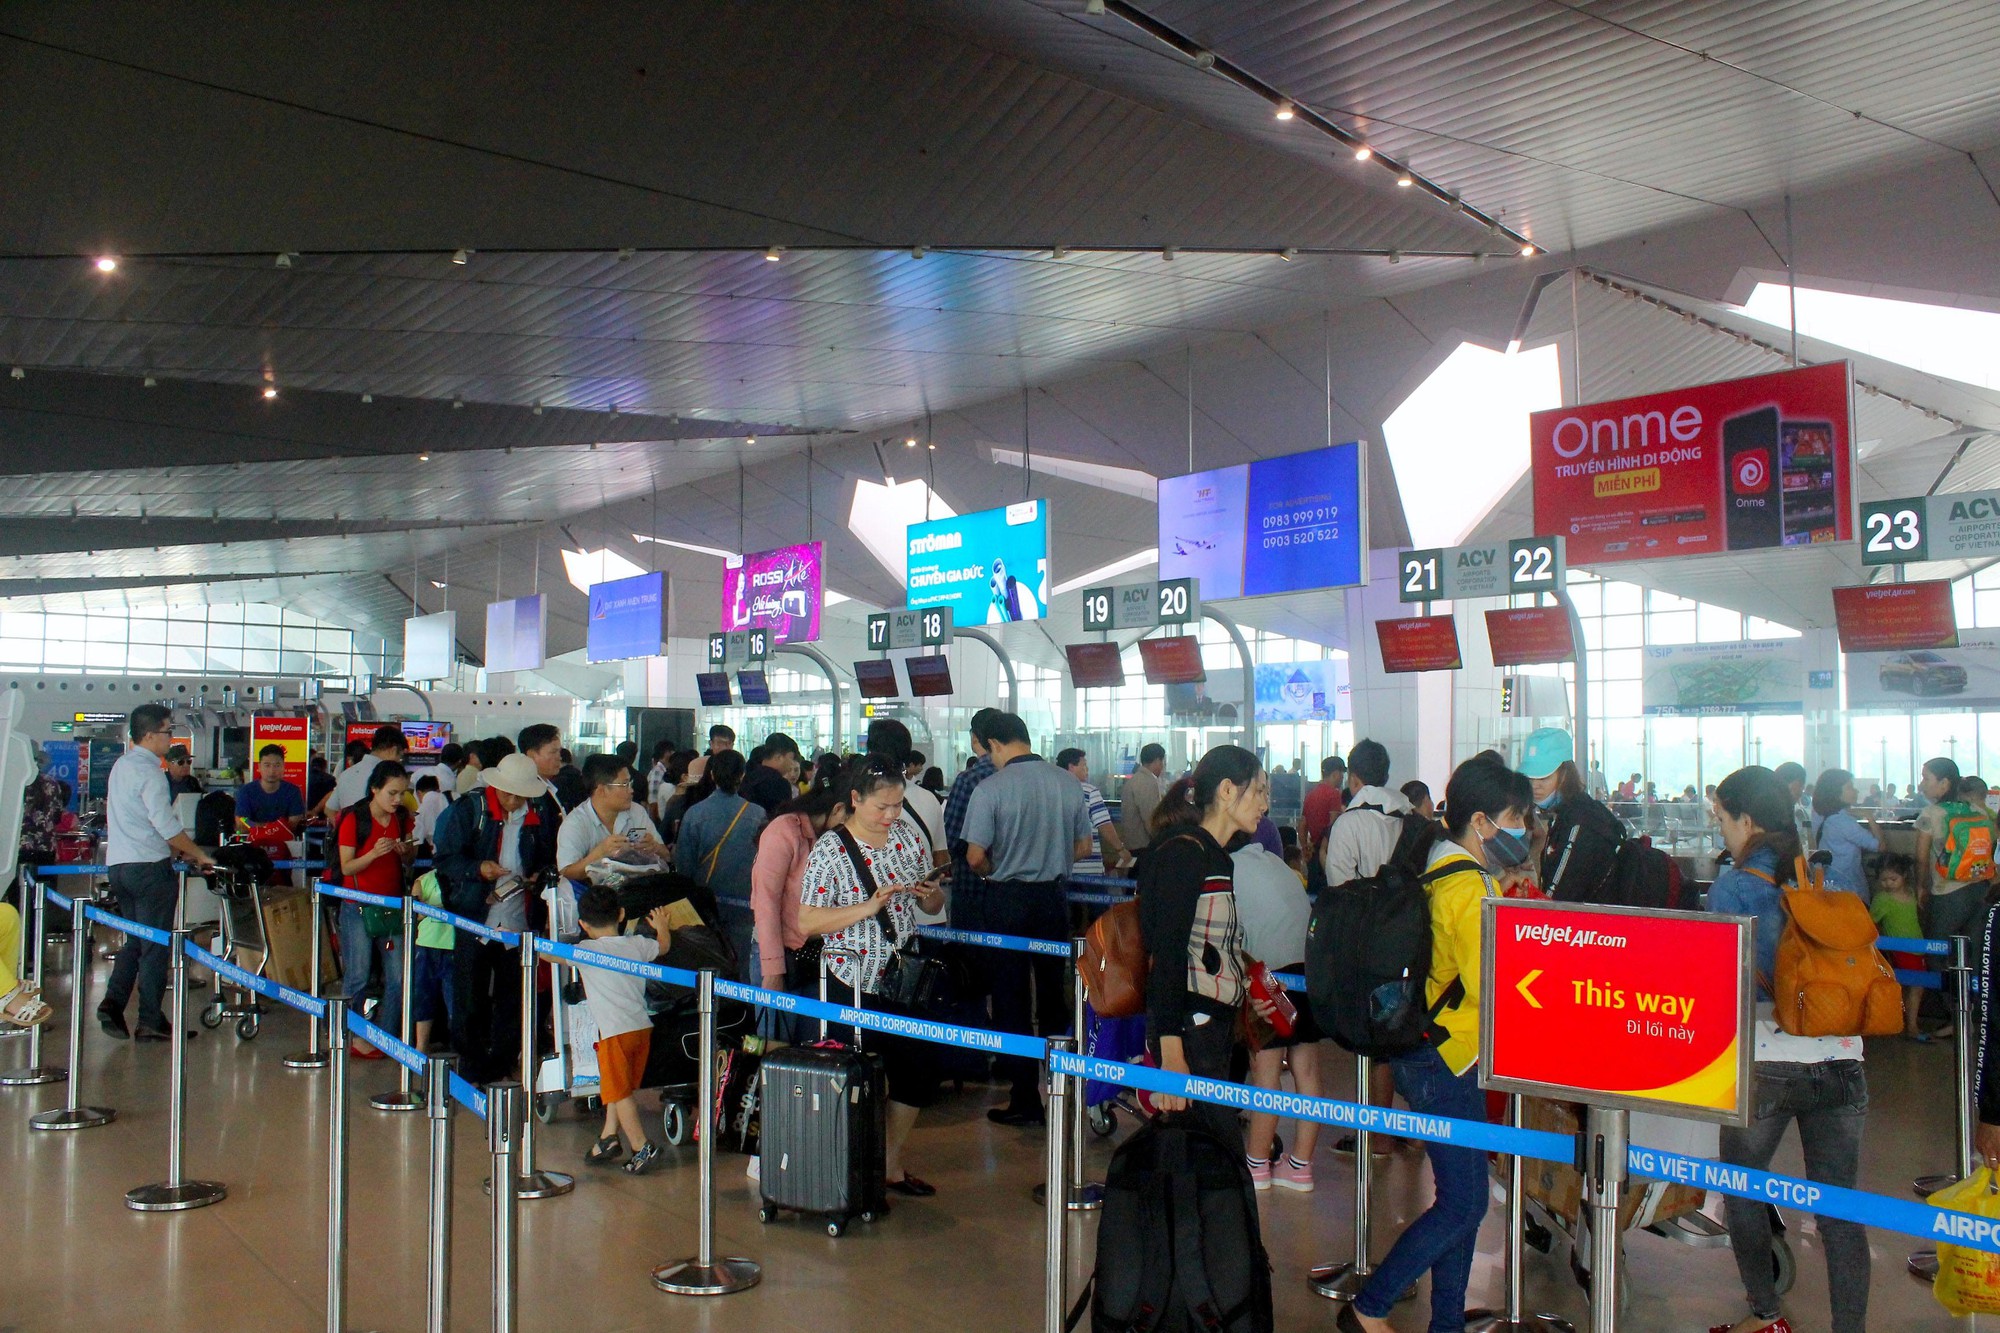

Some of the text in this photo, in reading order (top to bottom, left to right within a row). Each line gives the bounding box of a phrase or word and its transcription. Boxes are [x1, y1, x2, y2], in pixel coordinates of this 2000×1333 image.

[1552, 405, 1702, 458] Onme
[1608, 456, 1640, 471] HÌNH
[1644, 454, 1658, 466] DI
[1660, 447, 1702, 464] ĐỘNG
[1598, 470, 1656, 492] MIỄN PHÍ
[1736, 497, 1765, 508] Onme
[1263, 506, 1338, 528] 0983 999 919
[1264, 528, 1338, 548] 0903 520 522
[1866, 510, 1920, 552] 23
[1457, 550, 1496, 568] ACV
[1514, 546, 1552, 582] 22
[753, 570, 783, 587] ROSSI
[947, 569, 962, 582] GIA
[1405, 558, 1436, 592] 21
[1123, 588, 1149, 603] ACV
[1160, 586, 1188, 616] 20
[1086, 596, 1108, 622] 19
[870, 620, 886, 643] 17
[896, 615, 915, 626] ACV
[924, 614, 940, 638] 18
[711, 638, 722, 658] 15
[751, 634, 764, 654] 16
[1656, 706, 1674, 716] 750
[48, 764, 70, 778] 40
[1986, 907, 1997, 928] LOVE
[970, 934, 982, 943] NAM
[986, 936, 1002, 946] CTCP
[1028, 941, 1060, 954] AIRPORTS
[1983, 930, 1992, 952] LOVE
[542, 942, 662, 978] CTCP AIRPORTS CORPORATION OF VIETNAM
[1982, 954, 1990, 975] LOVE
[1981, 977, 1990, 998] LOVE
[1572, 979, 1695, 1024] This way
[714, 981, 1002, 1048] KHÔNG VIỆT NAM CTCP AIRPORTS CORPORATION OF VIETNAM
[1627, 1020, 1695, 1044] Đi lối này
[1977, 1046, 1986, 1068] LOVE
[1974, 1070, 1982, 1090] LOVE
[1061, 1056, 1085, 1074] NAM
[1094, 1062, 1126, 1080] CTCP
[1184, 1078, 1249, 1105] AIRPORTS
[1254, 1091, 1354, 1122] CORPORATION
[1358, 1108, 1378, 1126] OF
[1383, 1112, 1450, 1138] VIETNAM
[1660, 1156, 1700, 1184] VIỆT
[1704, 1166, 1747, 1192] NAM
[1765, 1178, 1820, 1207] CTCP
